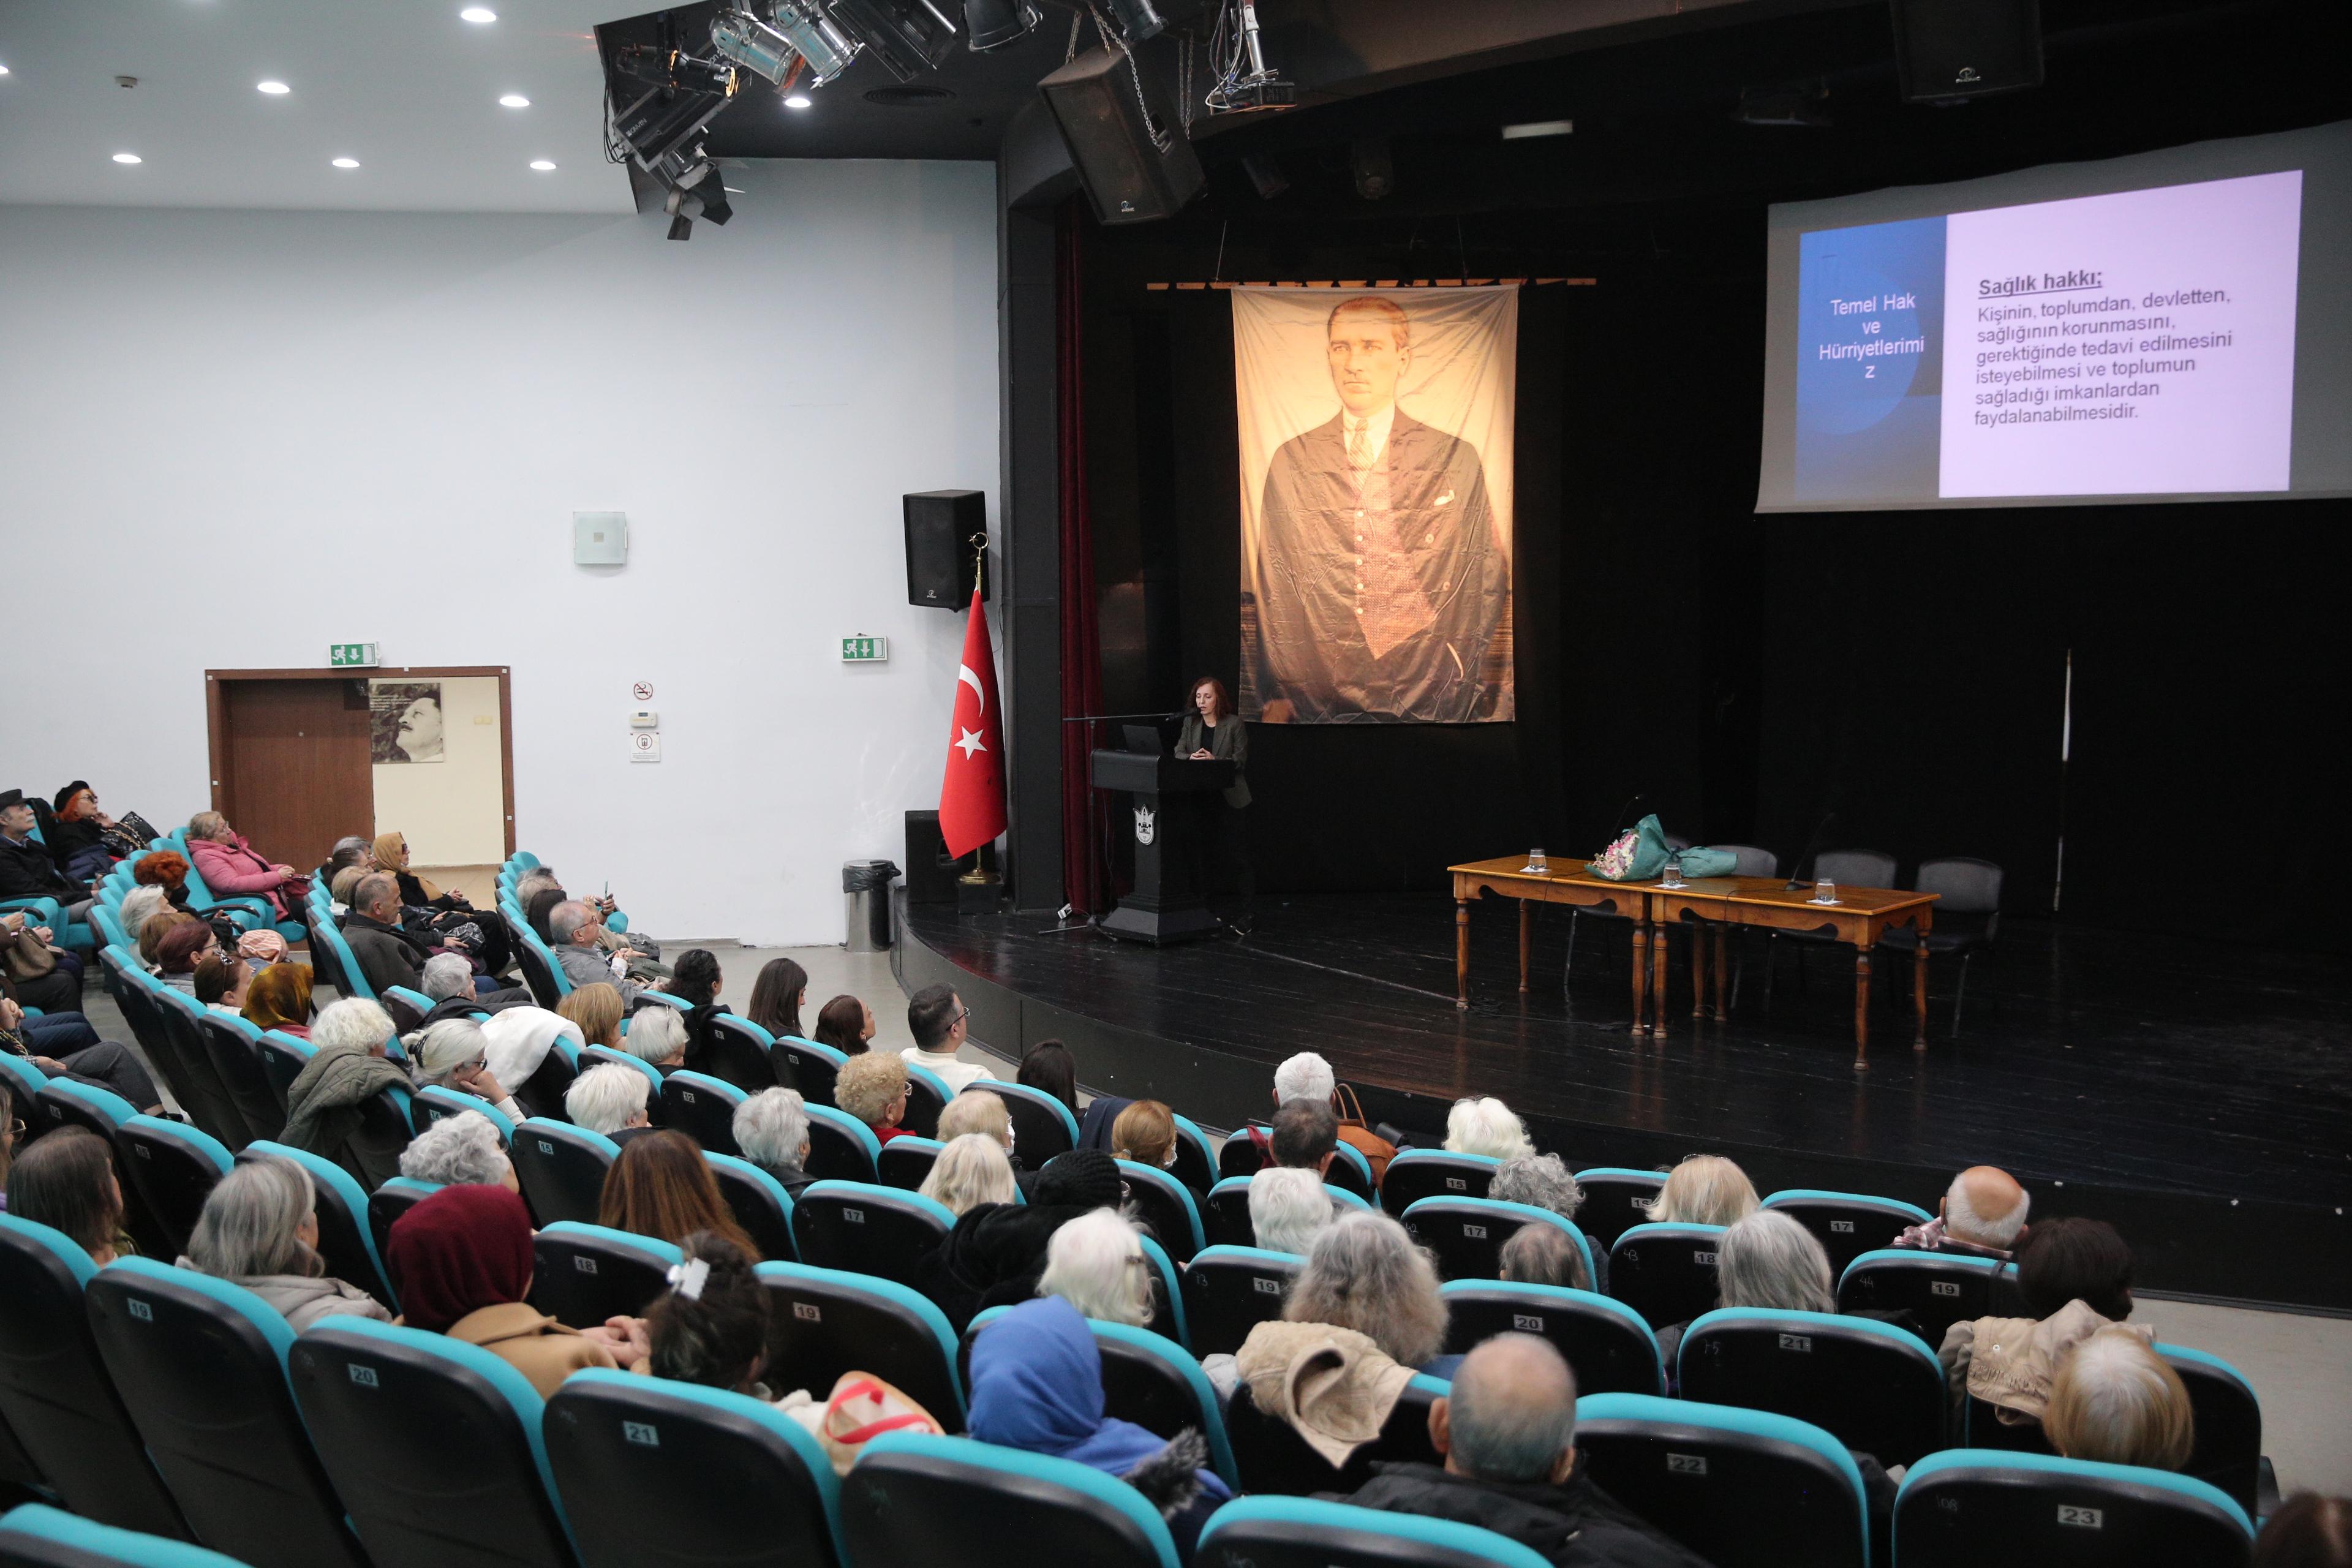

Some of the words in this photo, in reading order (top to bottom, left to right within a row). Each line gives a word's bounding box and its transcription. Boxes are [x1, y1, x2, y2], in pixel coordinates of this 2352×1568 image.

[1979, 275, 2037, 297] Sağlık
[2044, 270, 2102, 289] hakkı;
[1830, 296, 1877, 315] Temel
[1883, 293, 1916, 311] Hak
[1978, 304, 2037, 325] Kişinin,
[2041, 296, 2136, 319] toplumdan,
[2142, 289, 2231, 308] devletten,
[1862, 321, 1881, 334] ve
[1977, 325, 2057, 345] sağlığının
[2062, 316, 2176, 336] korunmasını,
[1819, 336, 1924, 361] Hürriyetlerimi
[1977, 342, 2076, 367] gerektiğinde
[2082, 338, 2133, 356] tedavi
[2139, 330, 2232, 352] edilmesini
[1864, 366, 1875, 379] z
[1976, 363, 2081, 386] isteyebilmesi
[2086, 365, 2106, 377] ve
[2112, 358, 2195, 379] toplumun
[1975, 387, 2049, 407] sağladığı
[2054, 381, 2159, 401] imkanlardan
[1975, 402, 2139, 428] faydalanabilmesidir.
[541, 1144, 551, 1153] 15
[847, 1211, 860, 1221] 17
[1467, 1227, 1482, 1236] 17
[1698, 1254, 1715, 1263] 18
[578, 1260, 593, 1272] 18
[1258, 1281, 1275, 1292] 19
[1936, 1284, 1954, 1294] 19
[132, 1303, 148, 1317] 19
[797, 1306, 815, 1319] 19
[1518, 1318, 1538, 1329] 20
[1784, 1337, 1803, 1349] 21
[353, 1369, 373, 1383] 20
[630, 1425, 650, 1442] 21
[1674, 1458, 1701, 1471] 22
[2064, 1509, 2095, 1525] 23
